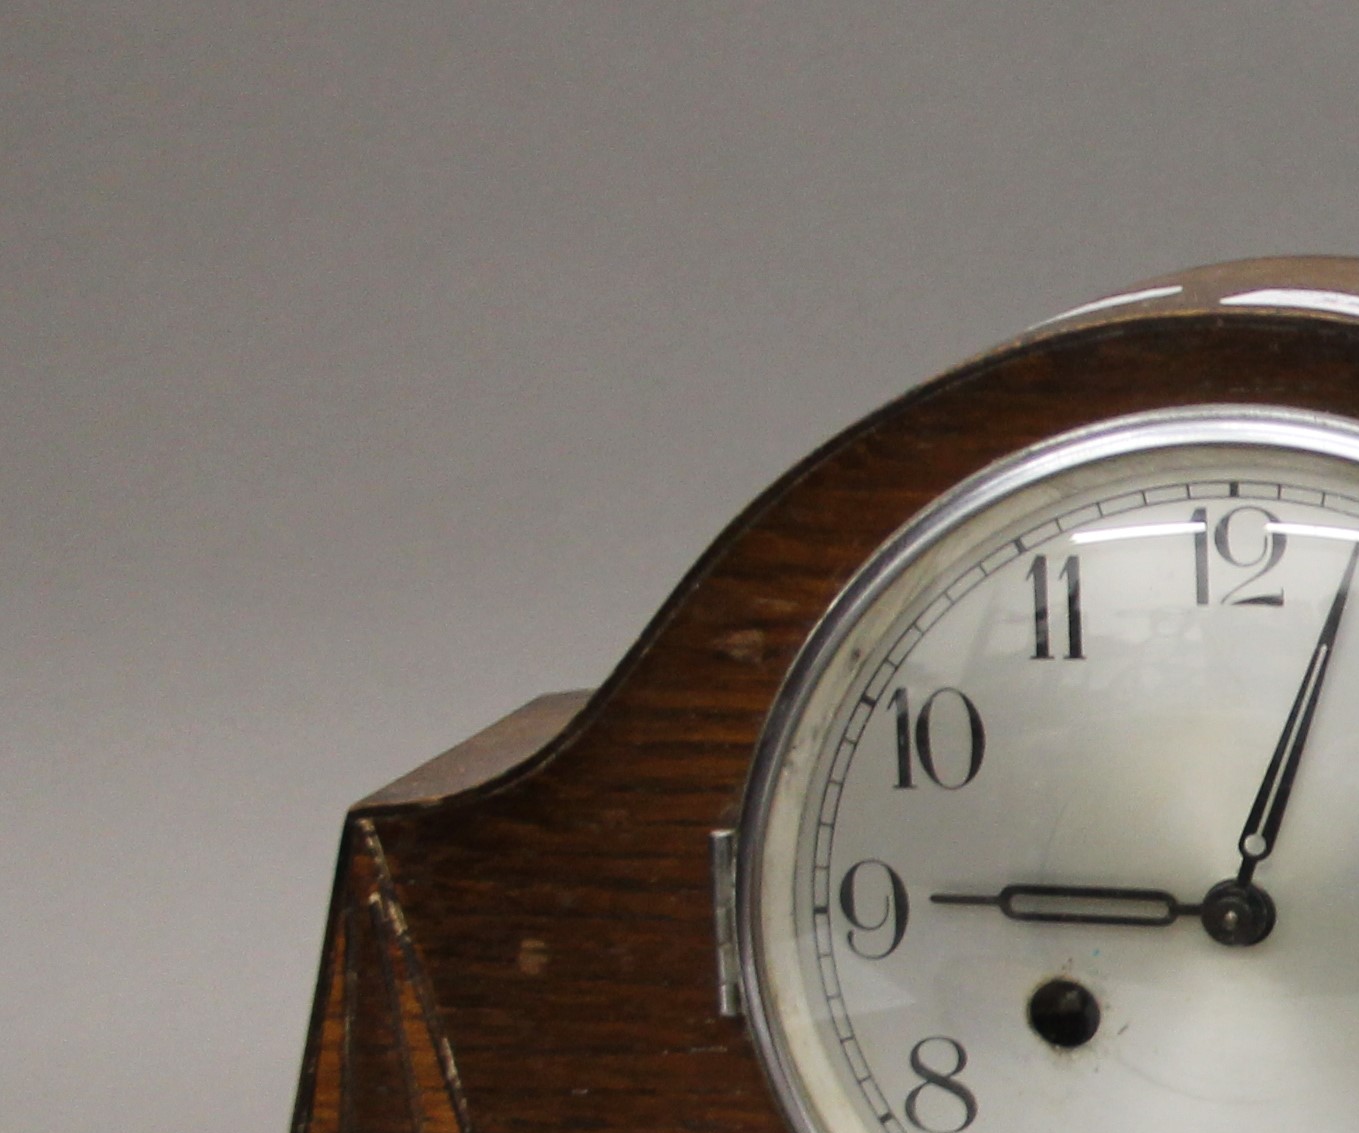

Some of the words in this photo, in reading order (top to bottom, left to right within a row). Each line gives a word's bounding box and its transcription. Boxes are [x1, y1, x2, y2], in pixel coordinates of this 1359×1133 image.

[1024, 553, 1087, 661] 11
[1190, 506, 1289, 608] 12
[885, 686, 987, 790] 10
[837, 859, 911, 960] 9
